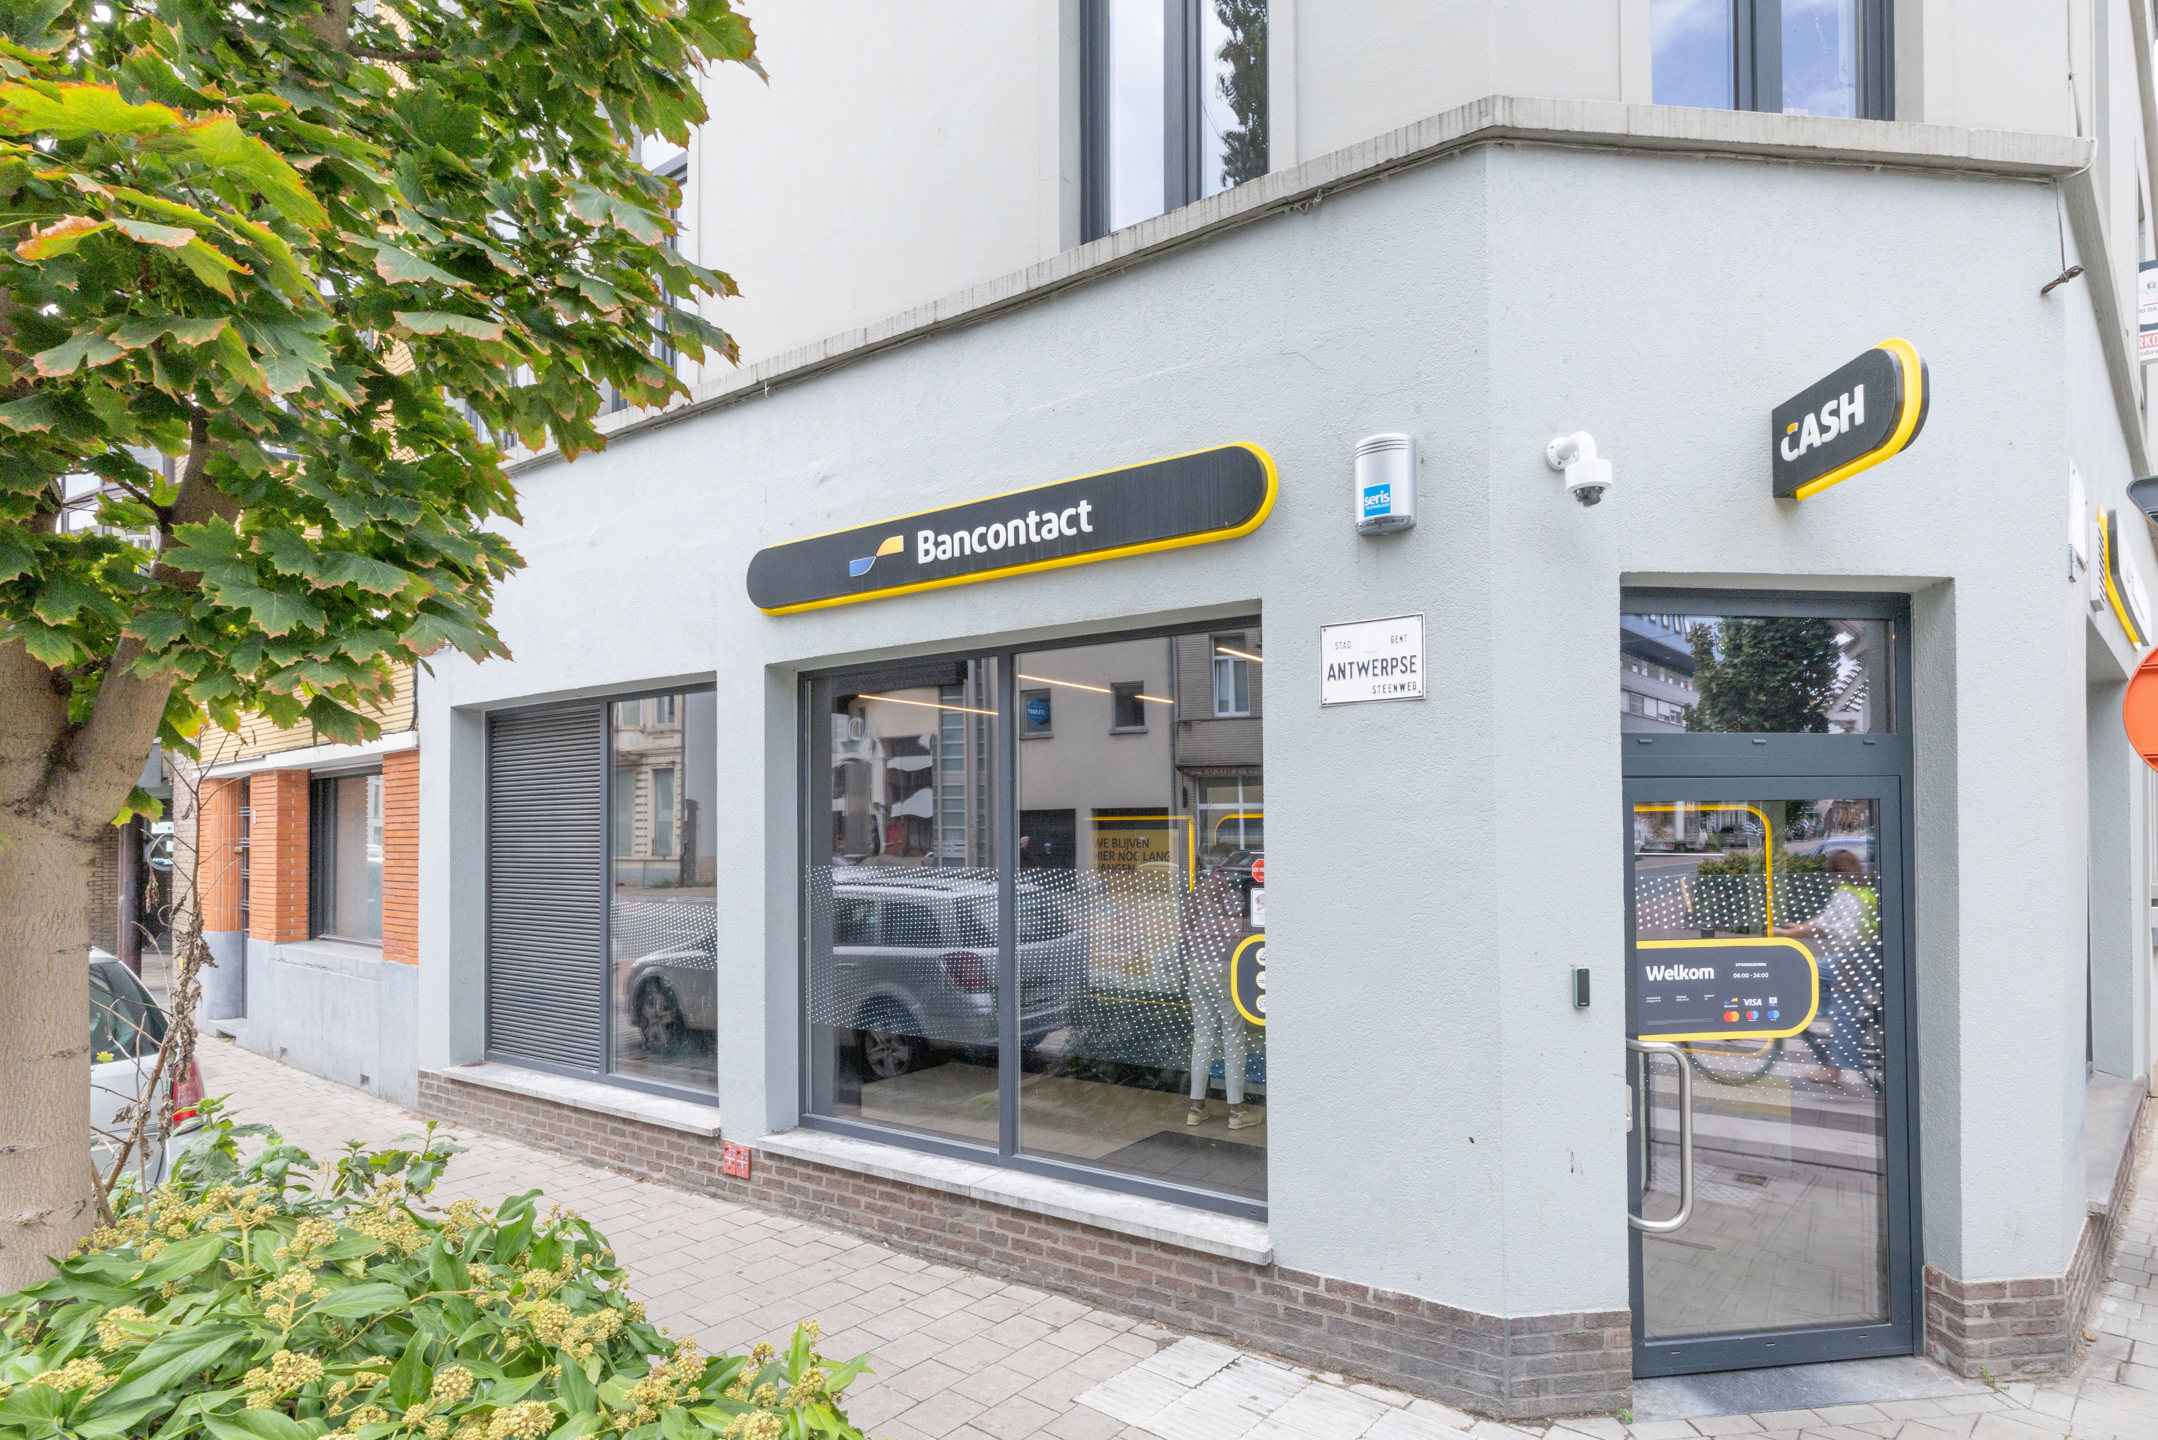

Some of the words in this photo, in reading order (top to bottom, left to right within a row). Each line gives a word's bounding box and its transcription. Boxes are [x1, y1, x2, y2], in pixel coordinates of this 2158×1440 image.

[1781, 384, 1864, 462] CASH
[1364, 490, 1390, 506] seris
[917, 500, 1093, 565] Bancontact
[1335, 641, 1352, 650] STAD
[1390, 634, 1407, 644] GENT
[1327, 655, 1417, 681] ANTWERPSE
[1372, 681, 1417, 694] STEENWEG
[1094, 838, 1109, 848] WE
[1112, 838, 1149, 850] BLIJVEN
[1094, 852, 1115, 861] HIER
[1118, 851, 1140, 861] NOG
[1143, 851, 1170, 862] LANG
[1646, 964, 1715, 981] Welkom
[1743, 998, 1762, 1006] VISA
